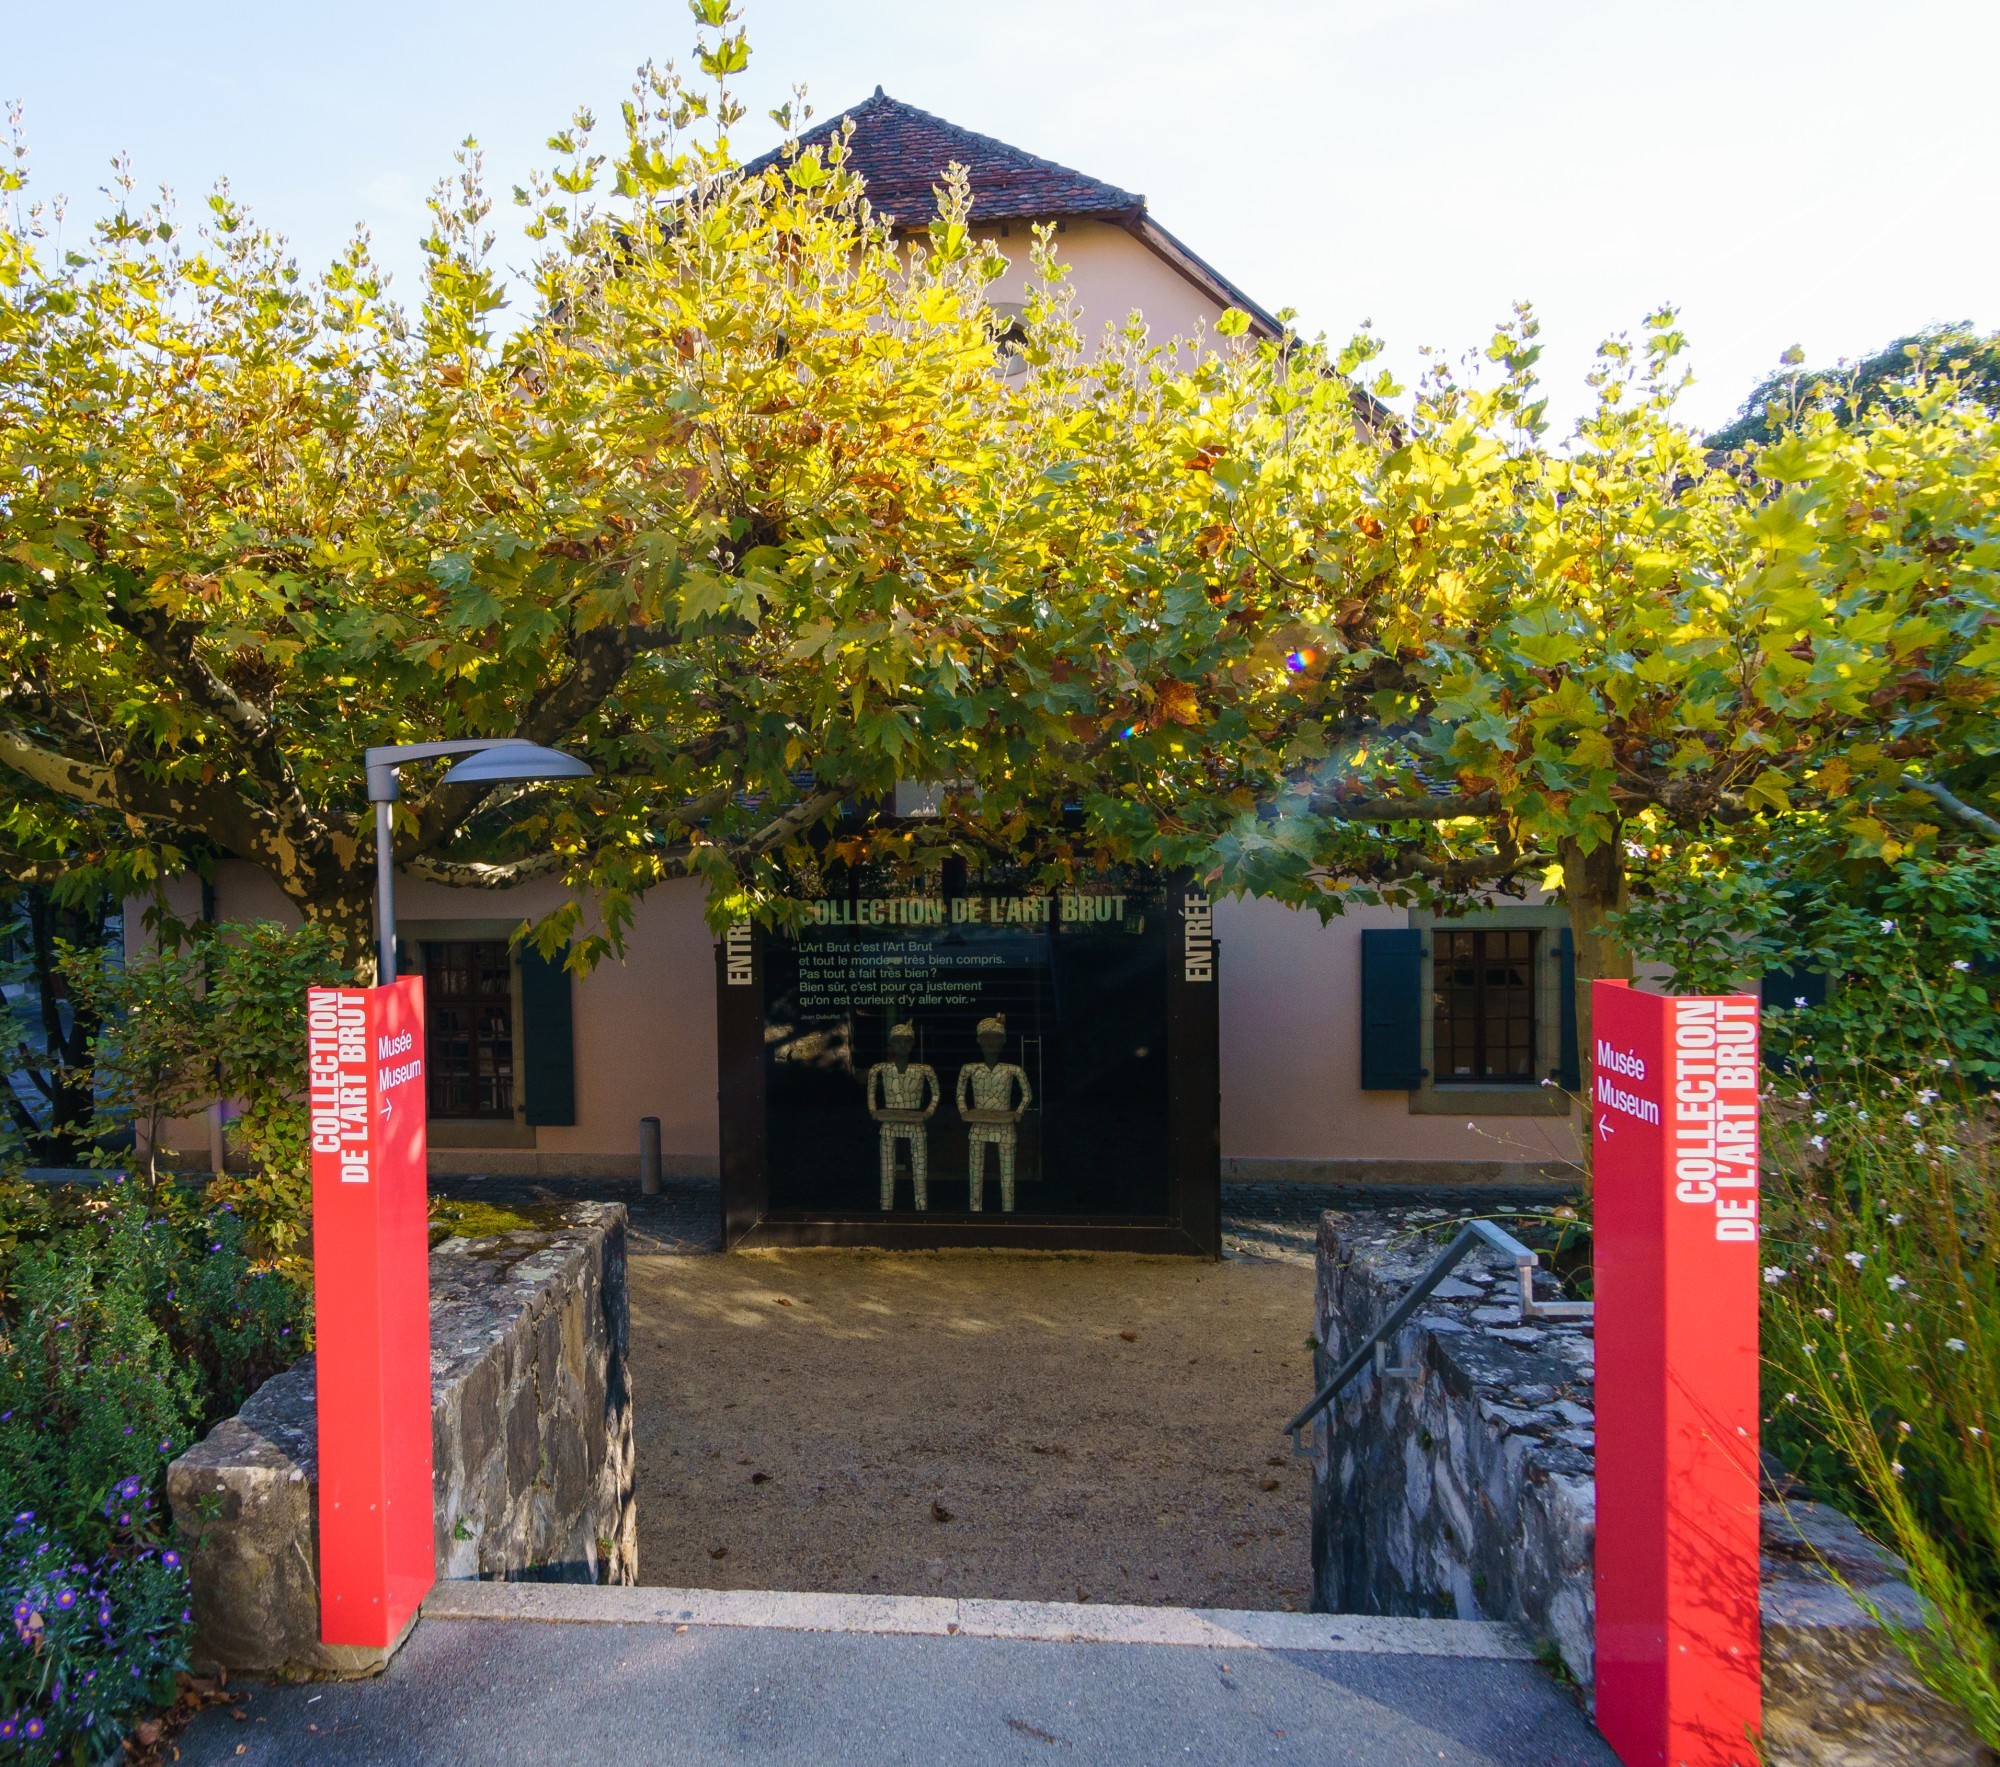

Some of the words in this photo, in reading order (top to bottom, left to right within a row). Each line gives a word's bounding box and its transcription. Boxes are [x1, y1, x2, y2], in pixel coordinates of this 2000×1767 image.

[951, 897, 982, 924] DE
[990, 896, 1054, 924] L'ART
[1062, 895, 1126, 922] BRUT
[727, 912, 752, 985] ENTR
[827, 942, 850, 952] Brut
[853, 942, 880, 952] c'est
[883, 941, 905, 952] l'Art
[908, 941, 932, 952] Brut
[1178, 893, 1213, 982] ENTRÉE
[799, 956, 810, 966] et
[813, 956, 835, 966] tout
[838, 955, 848, 966] le
[851, 955, 889, 966] monde
[904, 955, 926, 966] très
[929, 954, 953, 965] bien
[956, 954, 1006, 968] compris.
[800, 969, 820, 979] Pas
[823, 969, 845, 979] tout
[849, 968, 856, 979] à
[859, 968, 876, 979] fait
[880, 968, 901, 978] très
[904, 968, 929, 978] bien
[800, 982, 824, 992] Bien
[827, 981, 848, 993] sûr,
[851, 982, 877, 992] c'est
[880, 983, 906, 995] pour
[909, 983, 923, 994] ça
[926, 981, 982, 994] justement
[800, 996, 830, 1007] qu'on
[833, 996, 850, 1005] est
[853, 995, 894, 1005] curieux
[898, 995, 915, 1007] d'y
[918, 995, 941, 1005] aller
[945, 995, 968, 1005] voir.
[337, 992, 366, 1062] BRUT
[378, 1028, 413, 1061] Musée
[1716, 1001, 1757, 1090] BRUT
[310, 992, 341, 1152] COLLECTION
[378, 1058, 421, 1093] Museum
[1597, 1039, 1645, 1081] Musée
[340, 1071, 368, 1140] L'ART
[1598, 1075, 1659, 1126] Museum
[1675, 1000, 1717, 1204] COLLECTION
[1716, 1100, 1756, 1188] L'ART
[341, 1150, 369, 1183] DE
[1715, 1199, 1757, 1241] DE
